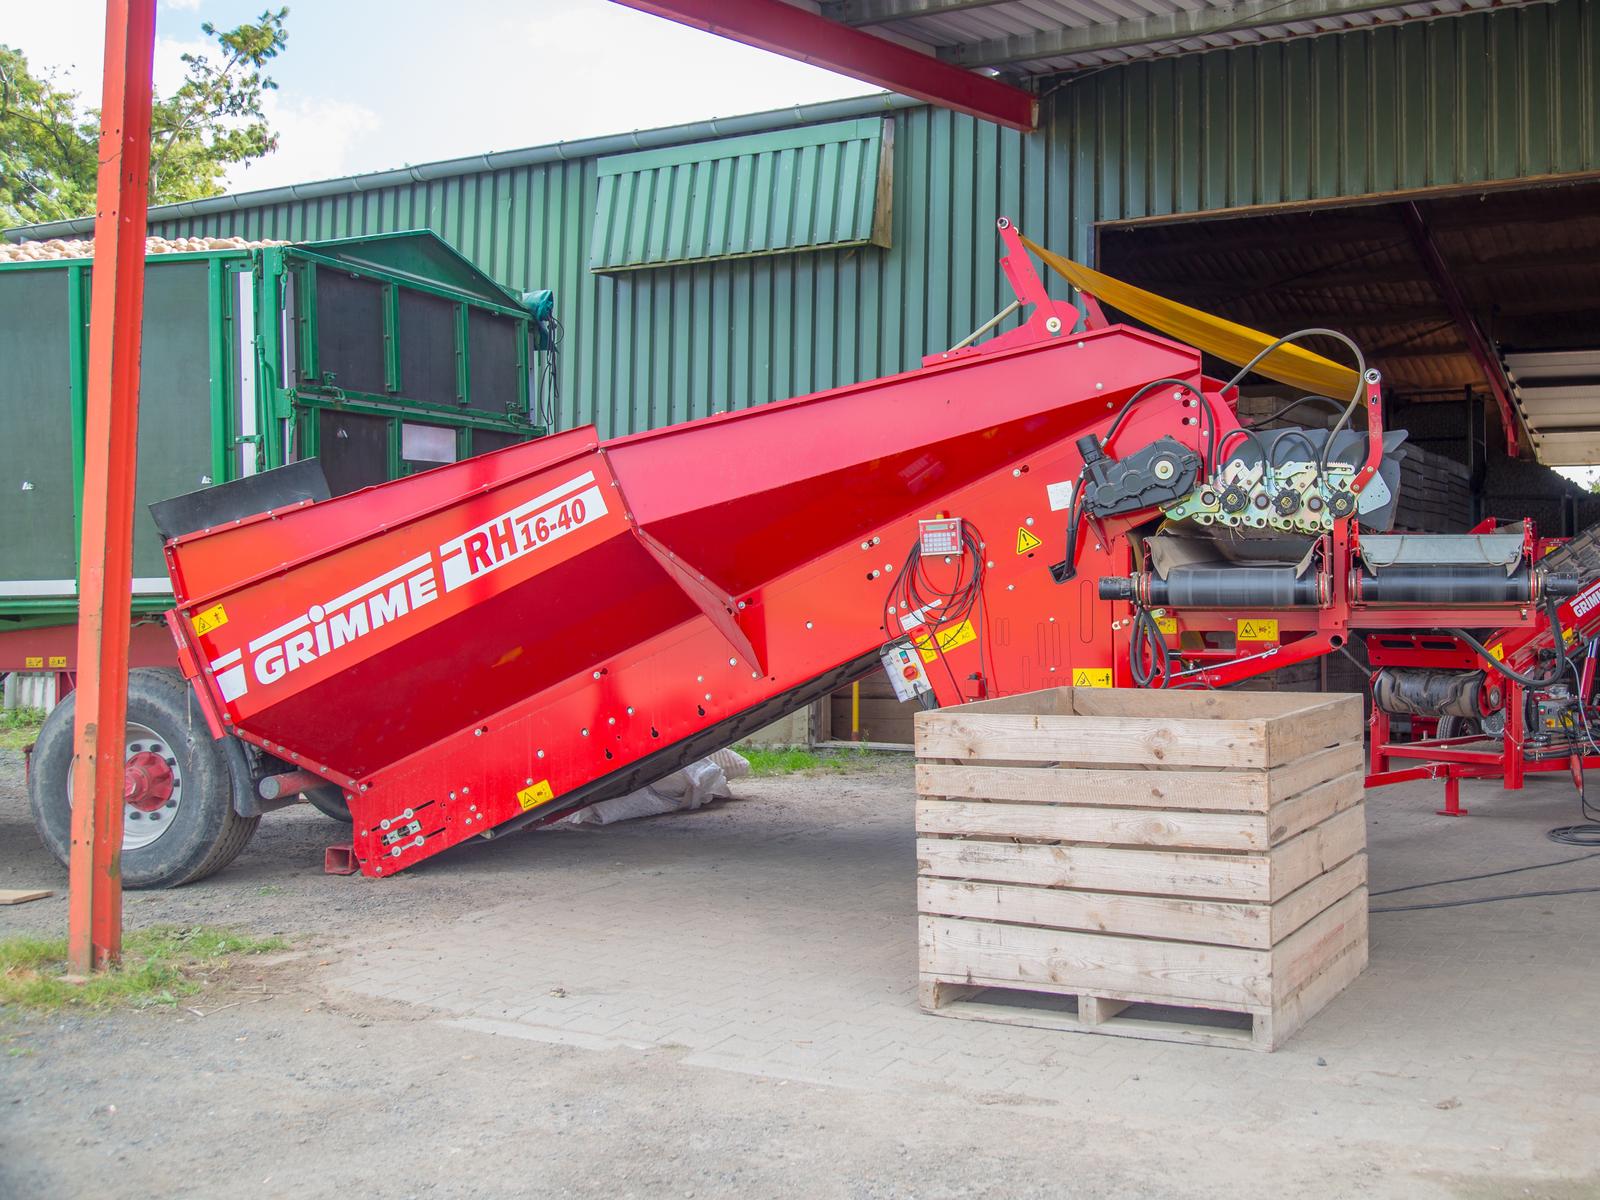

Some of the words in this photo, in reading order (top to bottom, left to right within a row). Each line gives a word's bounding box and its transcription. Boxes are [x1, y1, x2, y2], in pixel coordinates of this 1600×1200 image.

[254, 567, 438, 685] GRIMME
[463, 516, 519, 575] RH
[520, 498, 587, 551] 16-40
